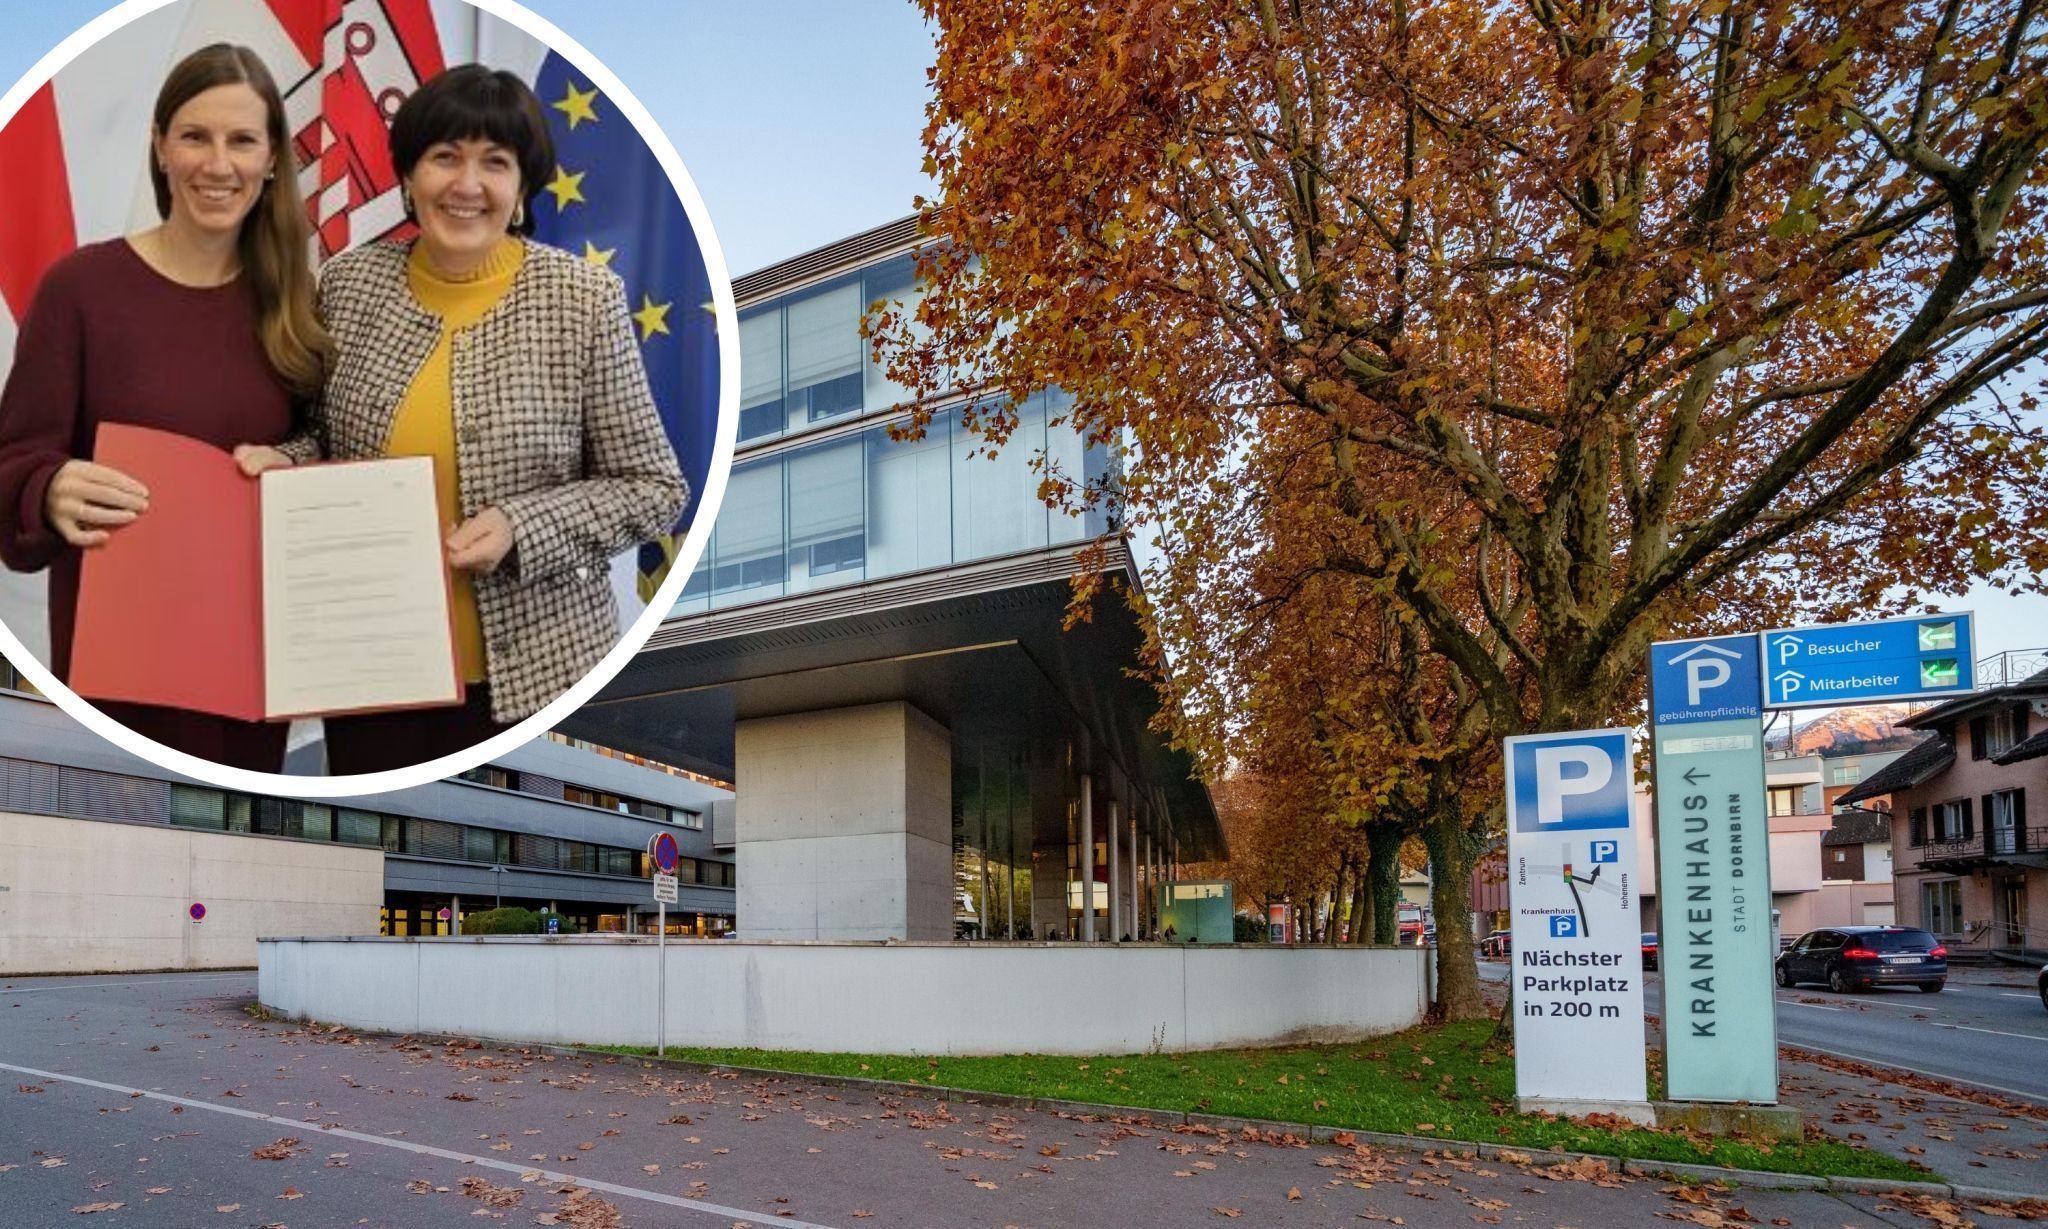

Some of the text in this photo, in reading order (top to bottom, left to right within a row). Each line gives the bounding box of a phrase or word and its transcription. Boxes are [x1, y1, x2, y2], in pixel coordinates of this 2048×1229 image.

[1808, 639, 1882, 656] Besucher
[1687, 658, 1731, 706] P
[1810, 675, 1900, 692] Mitarbeiter
[1659, 705, 1757, 722] gebührenpflichtig
[1535, 744, 1613, 824] P
[1595, 842, 1615, 862] P
[1728, 793, 1746, 933] STADT DORNBIRN
[1521, 907, 1576, 915] Krankenhaus
[1684, 794, 1717, 1037] KRANKENHAUS
[1556, 921, 1572, 936] P
[1522, 950, 1623, 967] Nächster
[1523, 975, 1629, 996] Parkplatz
[1524, 1000, 1620, 1018] in 200 m
